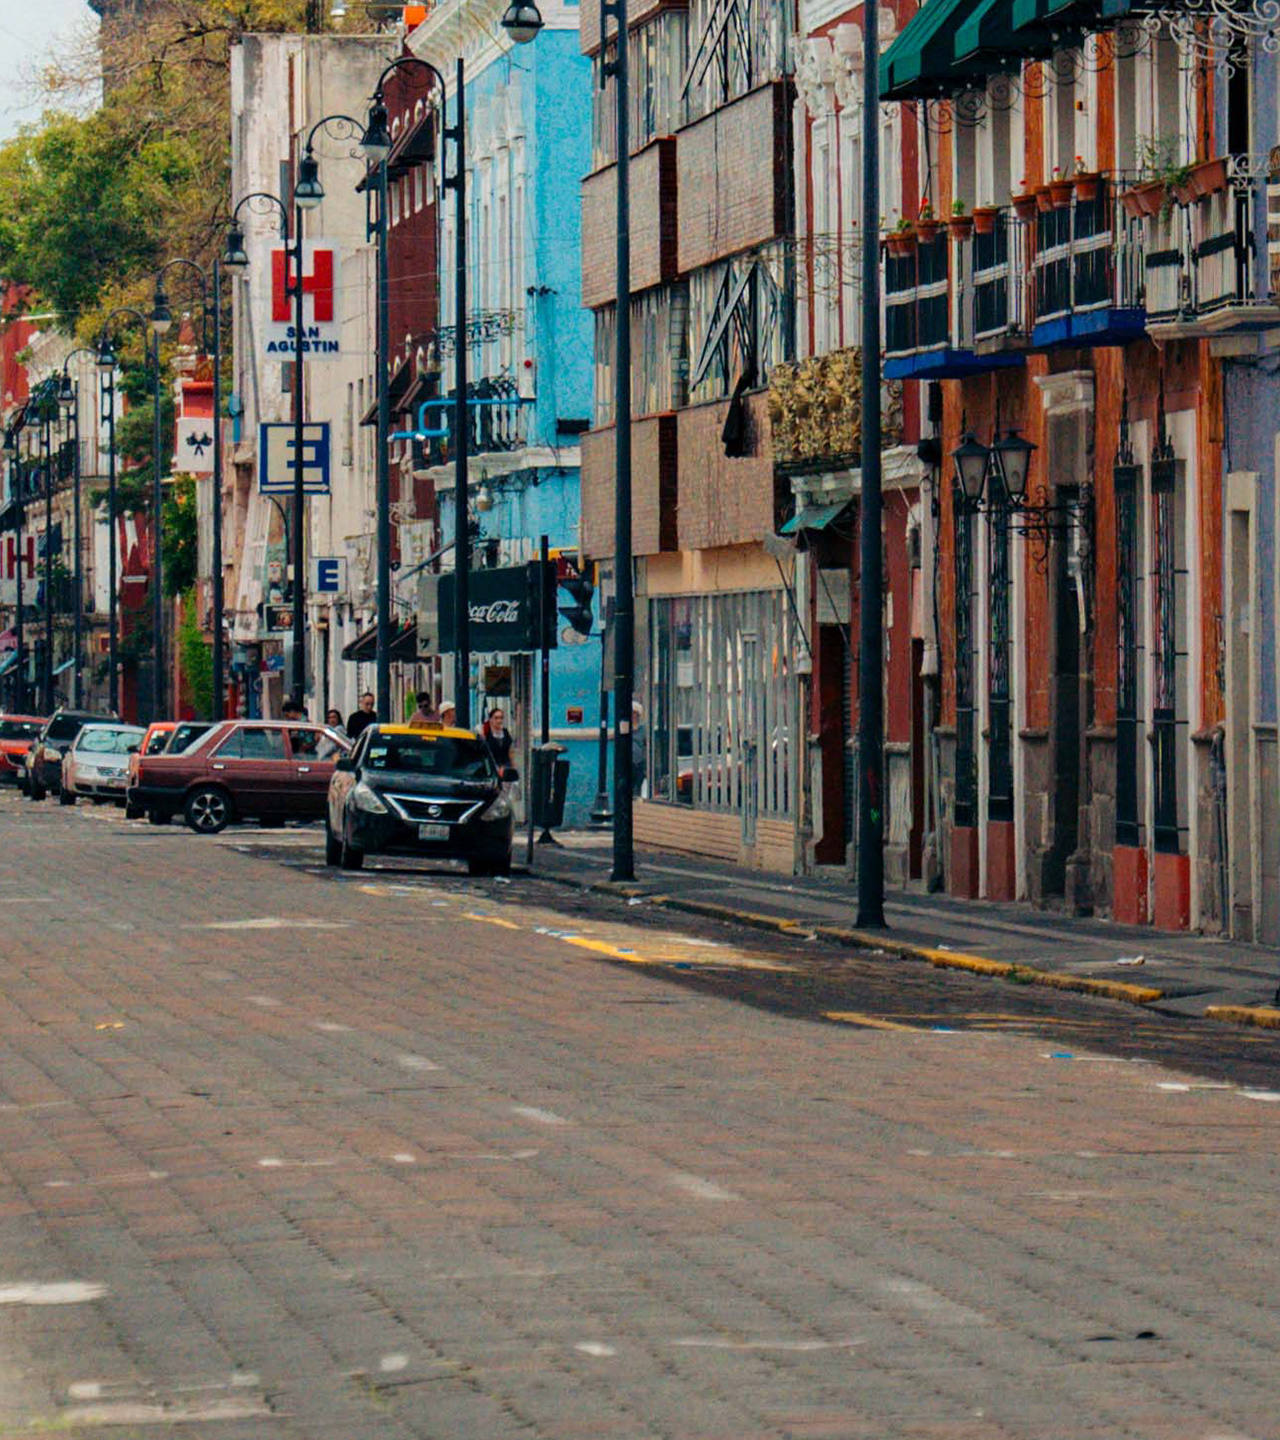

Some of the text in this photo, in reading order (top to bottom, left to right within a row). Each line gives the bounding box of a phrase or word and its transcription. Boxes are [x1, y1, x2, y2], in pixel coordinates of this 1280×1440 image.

[271, 249, 333, 322] H
[267, 341, 339, 352] AGUSTIN
[267, 426, 323, 482] E
[7, 537, 35, 579] H
[318, 560, 339, 592] E
